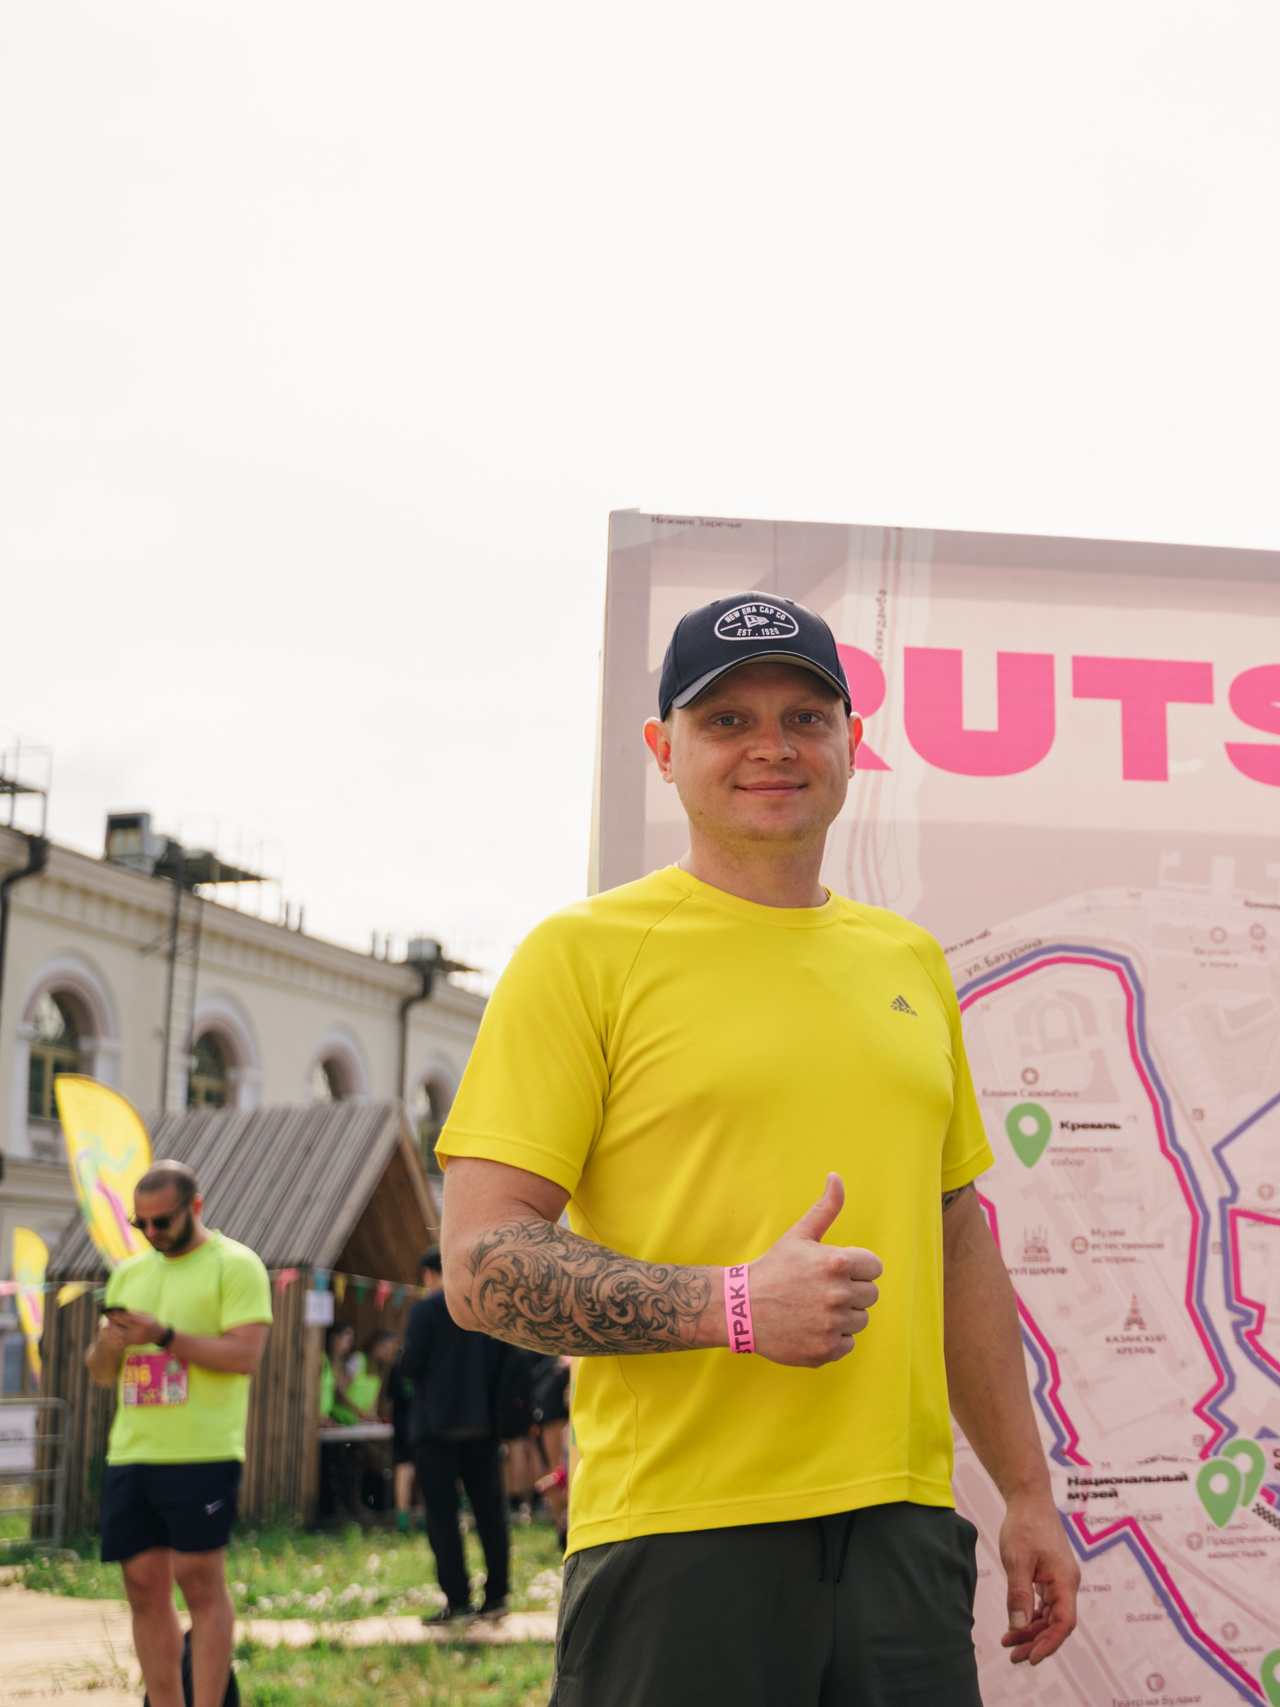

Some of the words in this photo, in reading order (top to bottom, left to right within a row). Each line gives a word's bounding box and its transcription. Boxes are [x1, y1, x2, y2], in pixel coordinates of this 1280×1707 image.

[724, 610, 741, 623] NEW
[742, 606, 757, 615] ERA
[760, 606, 774, 614] CAP
[775, 611, 786, 621] CO
[736, 628, 752, 636] EST
[761, 627, 779, 636] 1920
[1059, 1120, 1122, 1132] Кремль
[1066, 1471, 1190, 1488] Национальный
[1066, 1487, 1119, 1502] музей
